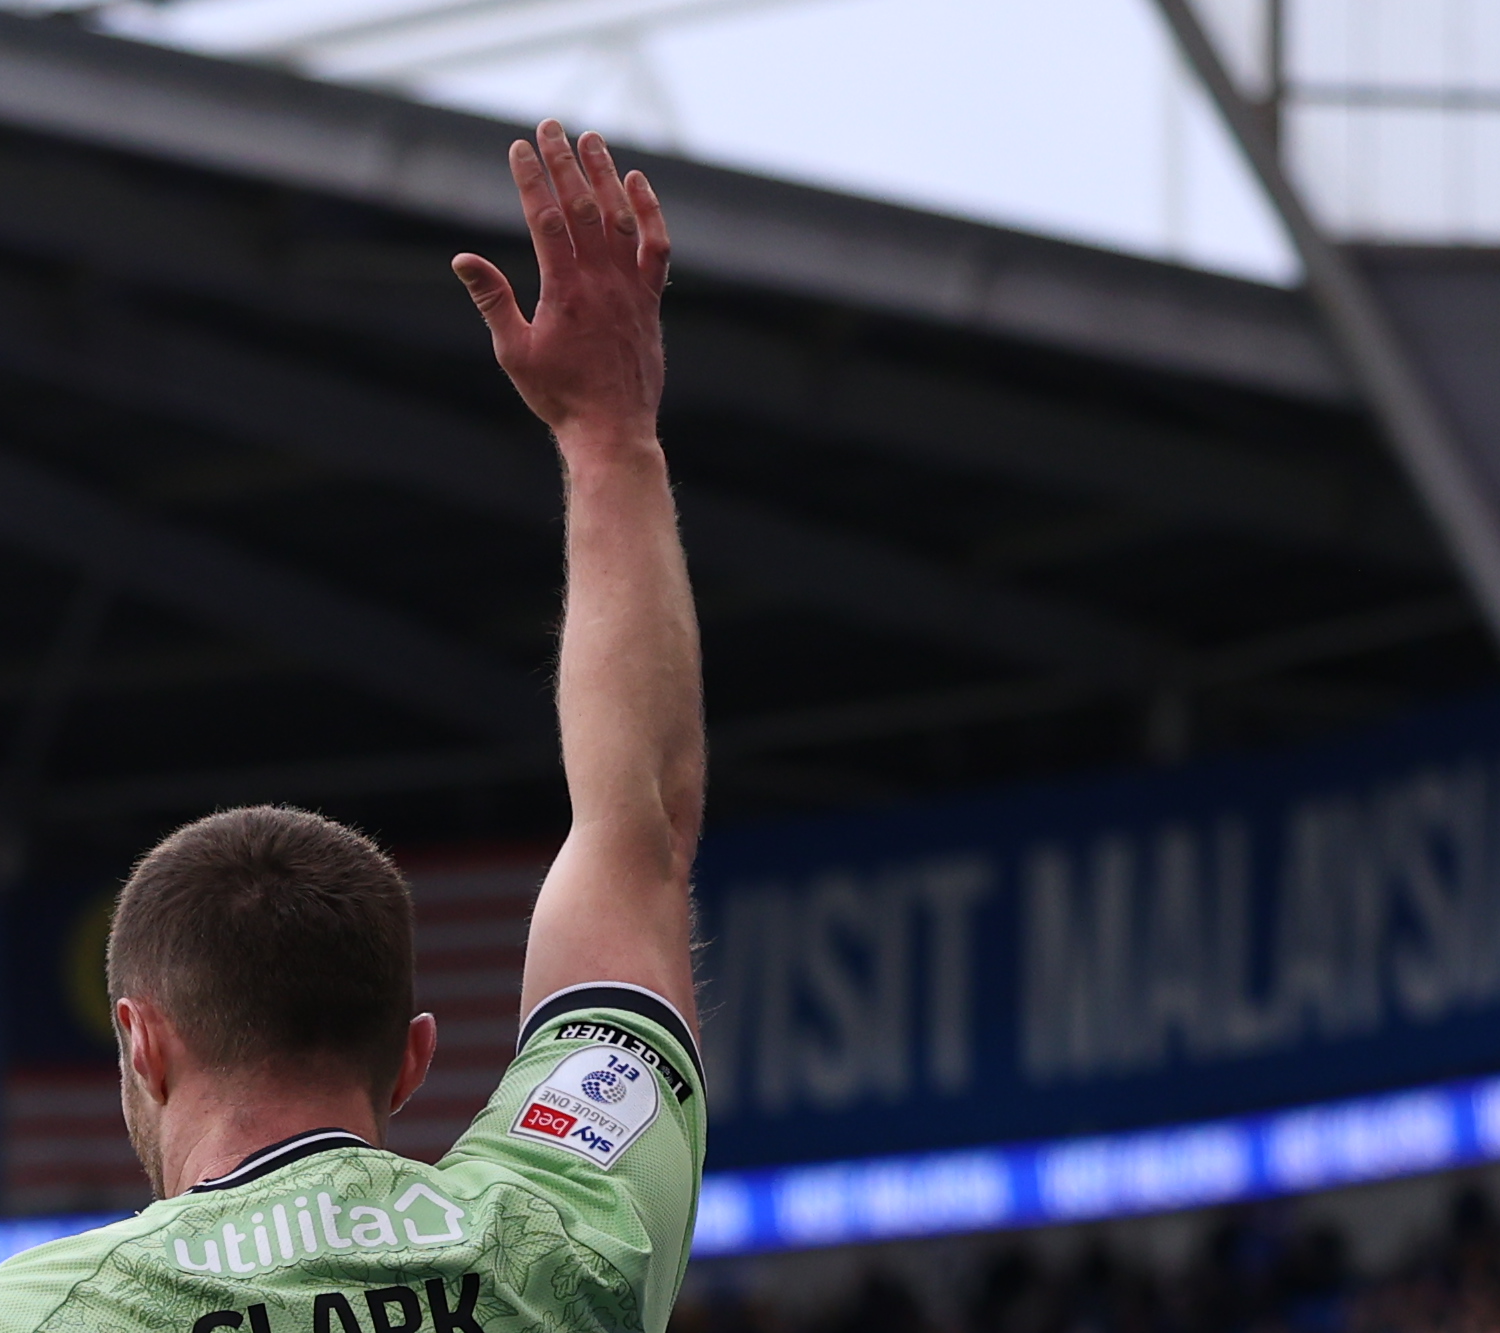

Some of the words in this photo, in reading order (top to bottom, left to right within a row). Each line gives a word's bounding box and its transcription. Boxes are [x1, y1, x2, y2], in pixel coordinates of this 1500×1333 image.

[608, 1054, 641, 1083] EFL
[538, 1090, 570, 1111] ONE
[528, 1109, 570, 1134] bet
[571, 1101, 625, 1138] LEAGUE
[571, 1125, 615, 1153] sky
[173, 1191, 399, 1274] utilita
